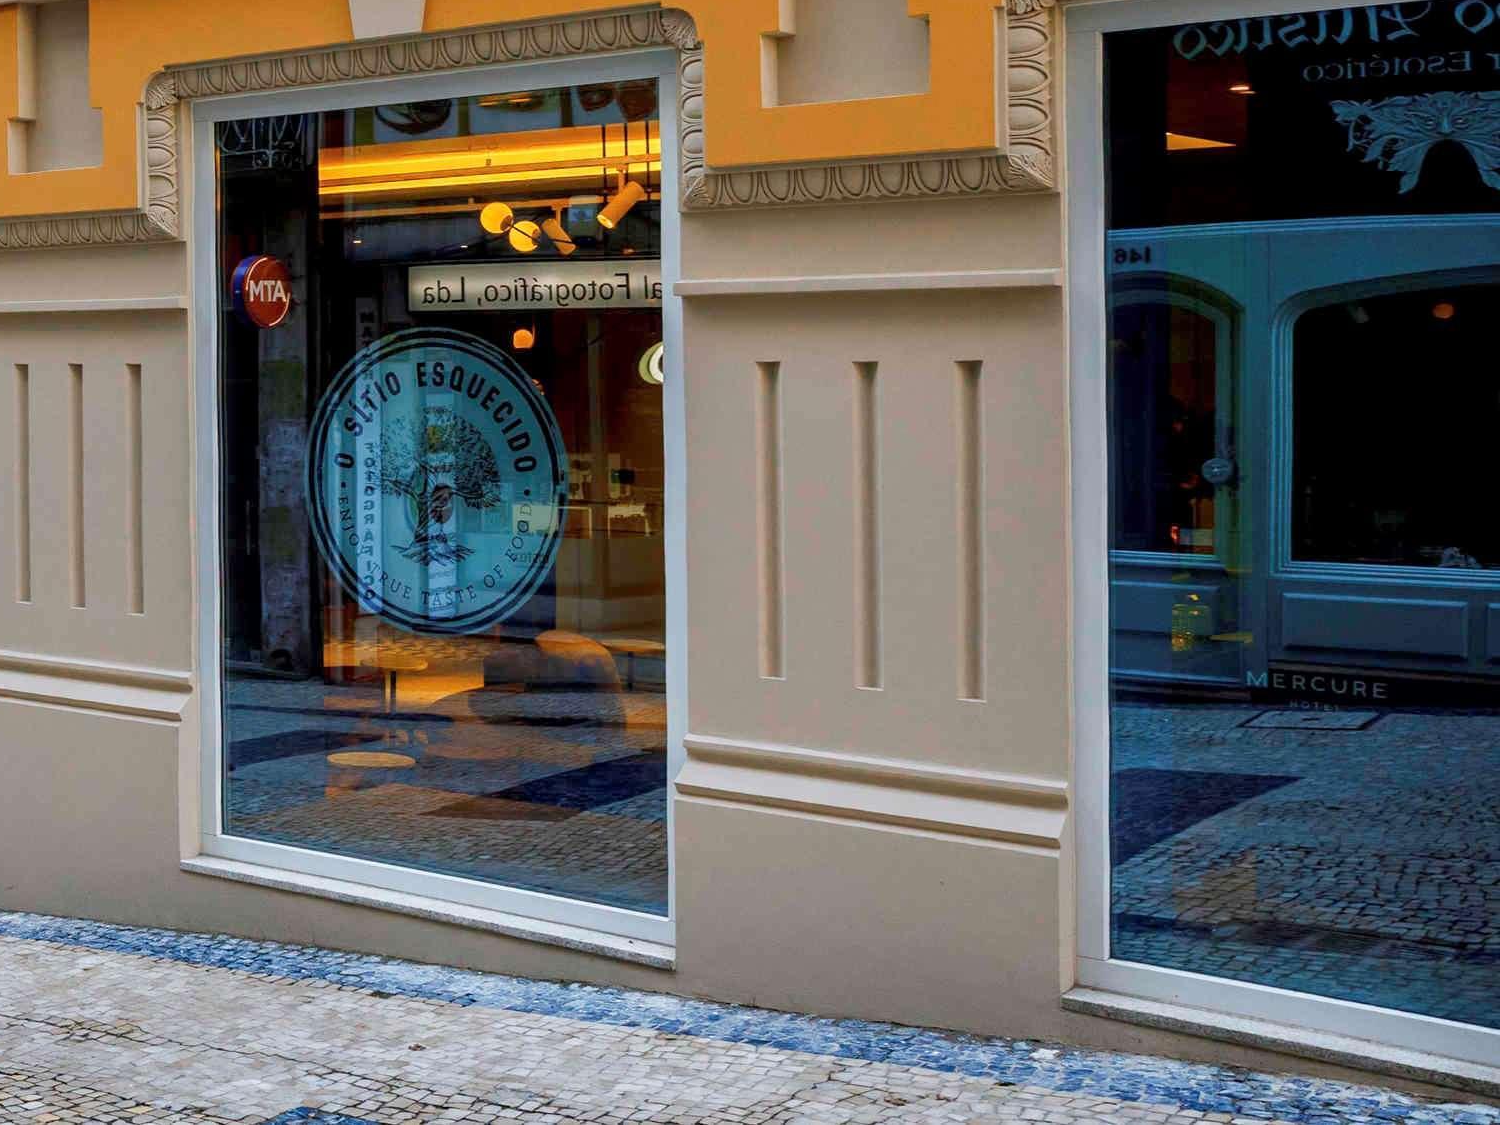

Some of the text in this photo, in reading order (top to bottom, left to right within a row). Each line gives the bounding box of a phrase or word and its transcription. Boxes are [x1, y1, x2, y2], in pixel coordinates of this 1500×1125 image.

[334, 452, 354, 469] O
[344, 371, 401, 437] SÍTIO
[415, 361, 537, 472] ESQUECIDO
[420, 586, 477, 606] TASTE
[483, 563, 505, 589] OF
[504, 503, 533, 563] FOOD
[1246, 671, 1388, 699] MERCURE
